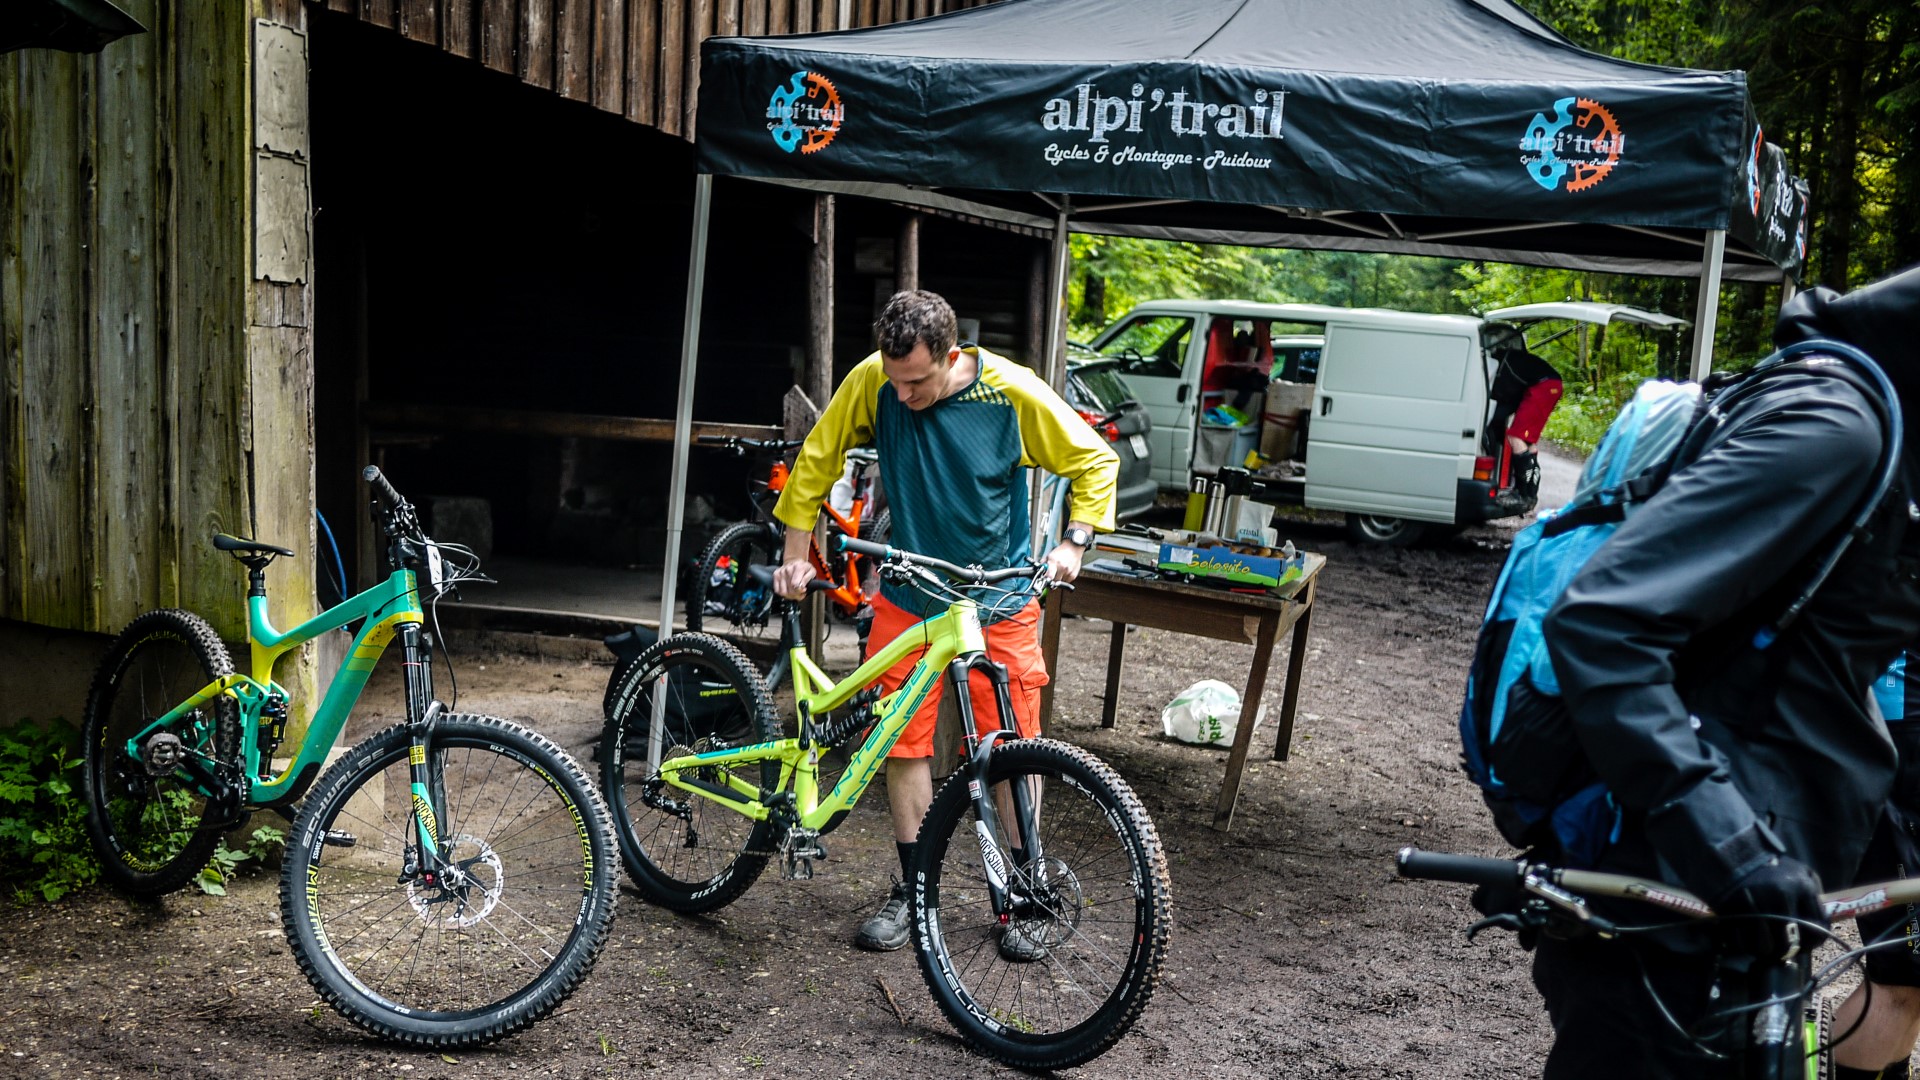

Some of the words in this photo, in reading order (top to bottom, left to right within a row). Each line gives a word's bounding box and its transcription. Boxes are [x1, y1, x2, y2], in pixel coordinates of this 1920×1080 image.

[766, 101, 845, 122] alpi'trail
[1041, 79, 1290, 142] alpi'trail
[1044, 143, 1090, 167] Cycles
[1094, 145, 1110, 163] &
[1112, 146, 1193, 170] Montagne
[1203, 150, 1272, 170] Puidoux
[1519, 131, 1626, 155] alpi'trail
[1239, 527, 1260, 537] cristal
[834, 659, 927, 798] INTENSE
[845, 671, 942, 805] INTENSE
[302, 748, 385, 849] SCHWALBE
[312, 840, 321, 860] SWISS
[580, 896, 588, 914] SWISS
[916, 871, 931, 951] MAXXIS
[497, 977, 552, 1019] MAGIC
[937, 954, 987, 1024] HELIX
